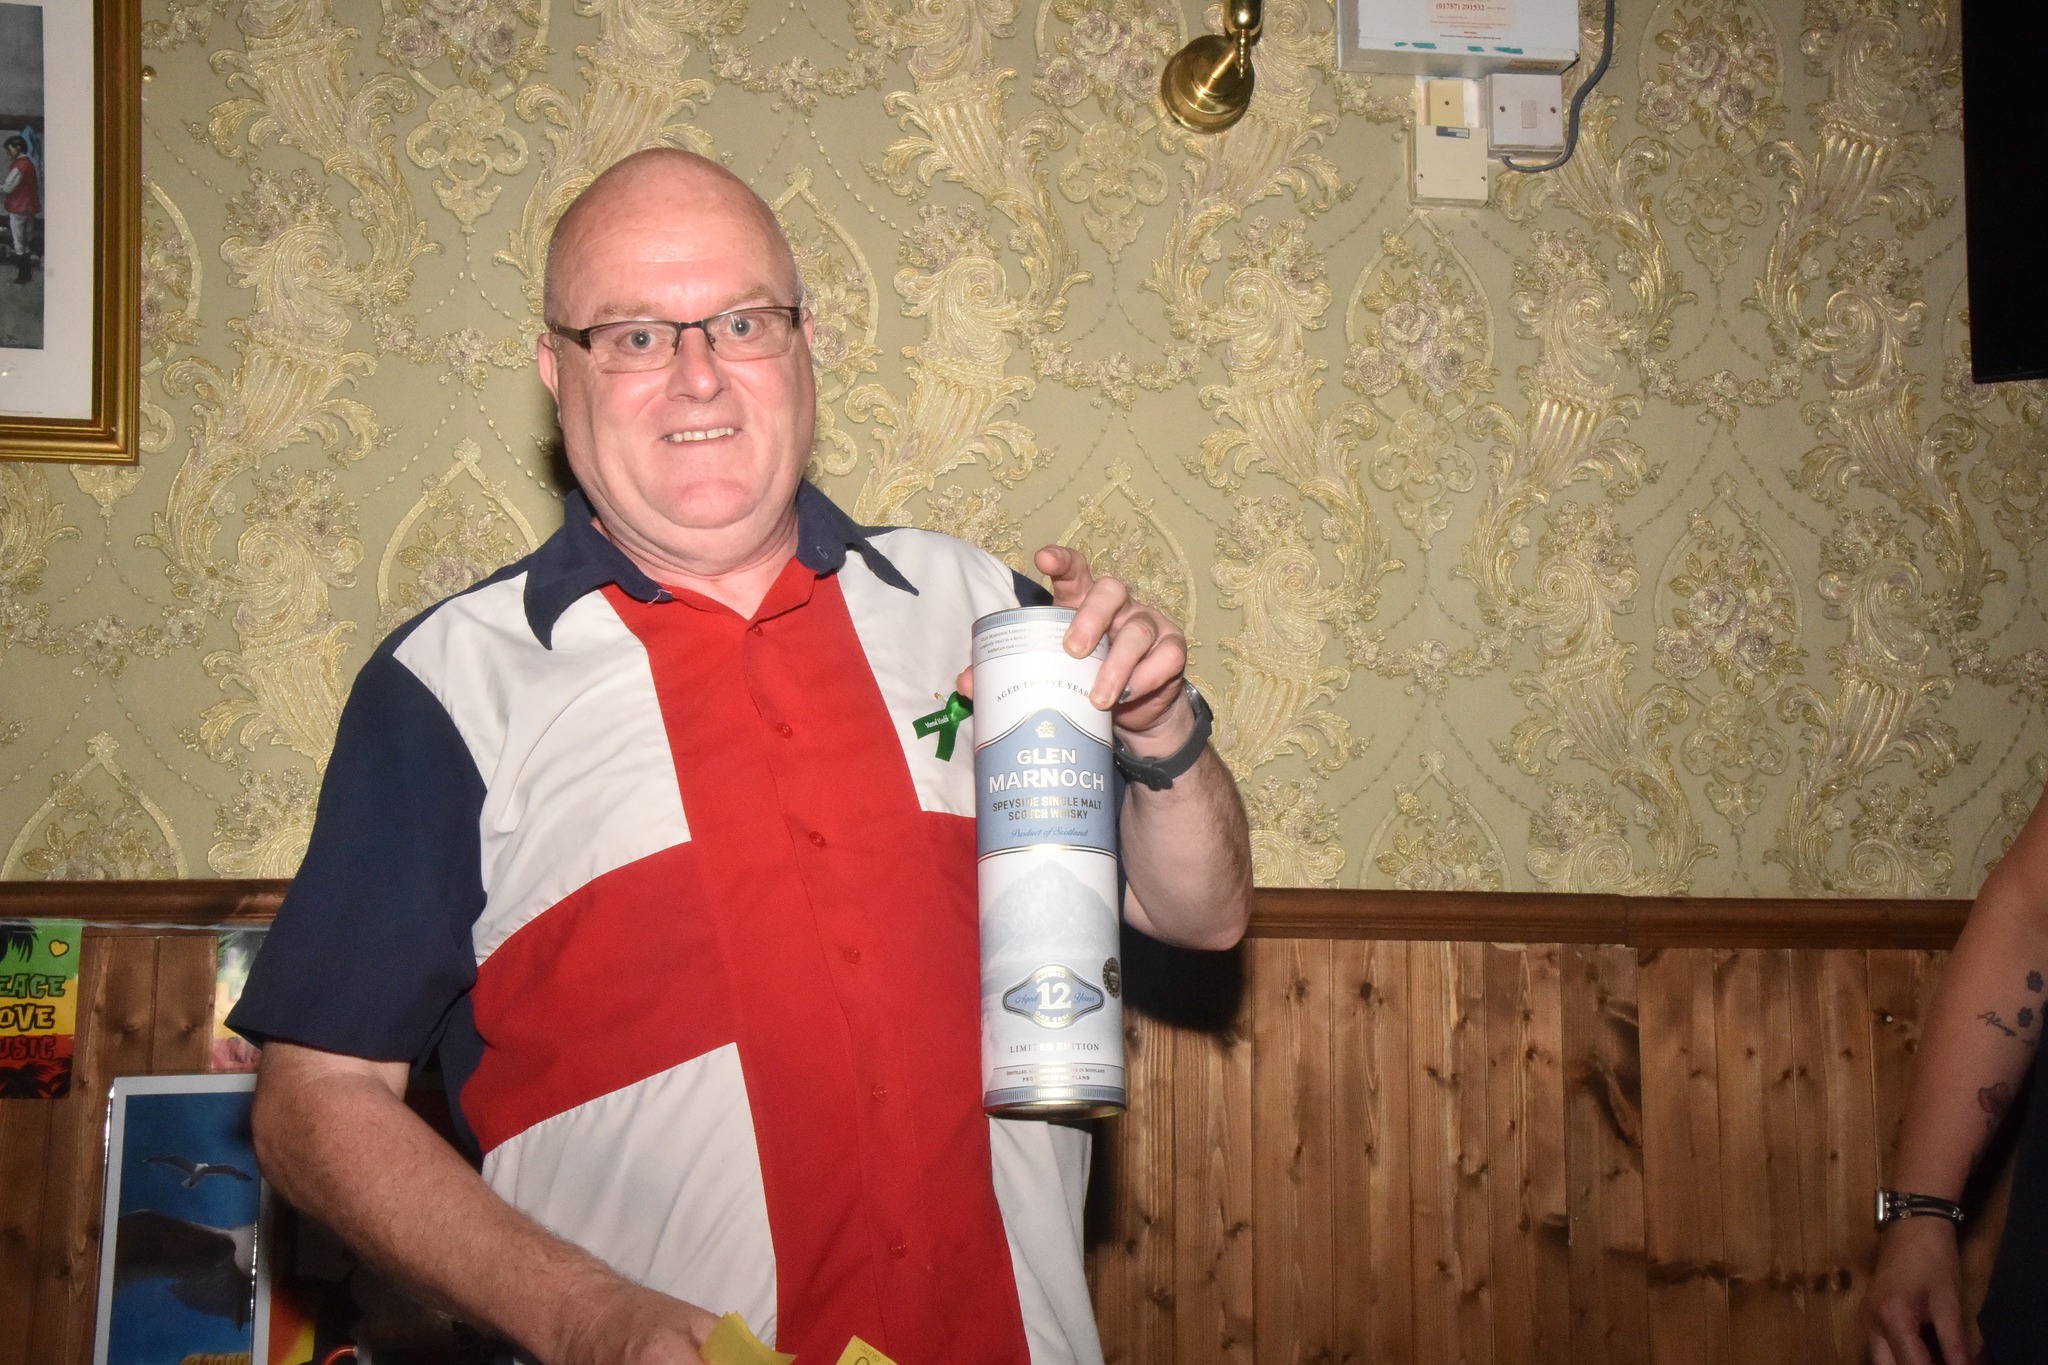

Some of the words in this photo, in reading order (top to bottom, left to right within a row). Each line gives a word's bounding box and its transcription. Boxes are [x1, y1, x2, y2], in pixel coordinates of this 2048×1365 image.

[997, 684, 1019, 703] AGED
[1023, 678, 1064, 689] TWLVE
[1067, 682, 1091, 700] YEAR
[1016, 747, 1076, 765] GLEN
[989, 767, 1104, 793] MARNOCH
[992, 797, 1039, 812] SPEYSIDE
[1041, 796, 1078, 807] SINGLE
[1081, 797, 1102, 811] MALT
[1008, 808, 1048, 821] SCOTCH
[1050, 808, 1088, 820] WHISKY
[1009, 828, 1042, 839] Product
[1043, 827, 1052, 837] of
[1053, 827, 1089, 837] Scotland
[1036, 981, 1072, 1010] 12
[1009, 1042, 1054, 1054] LIMITED
[1056, 1042, 1100, 1051] EDITION
